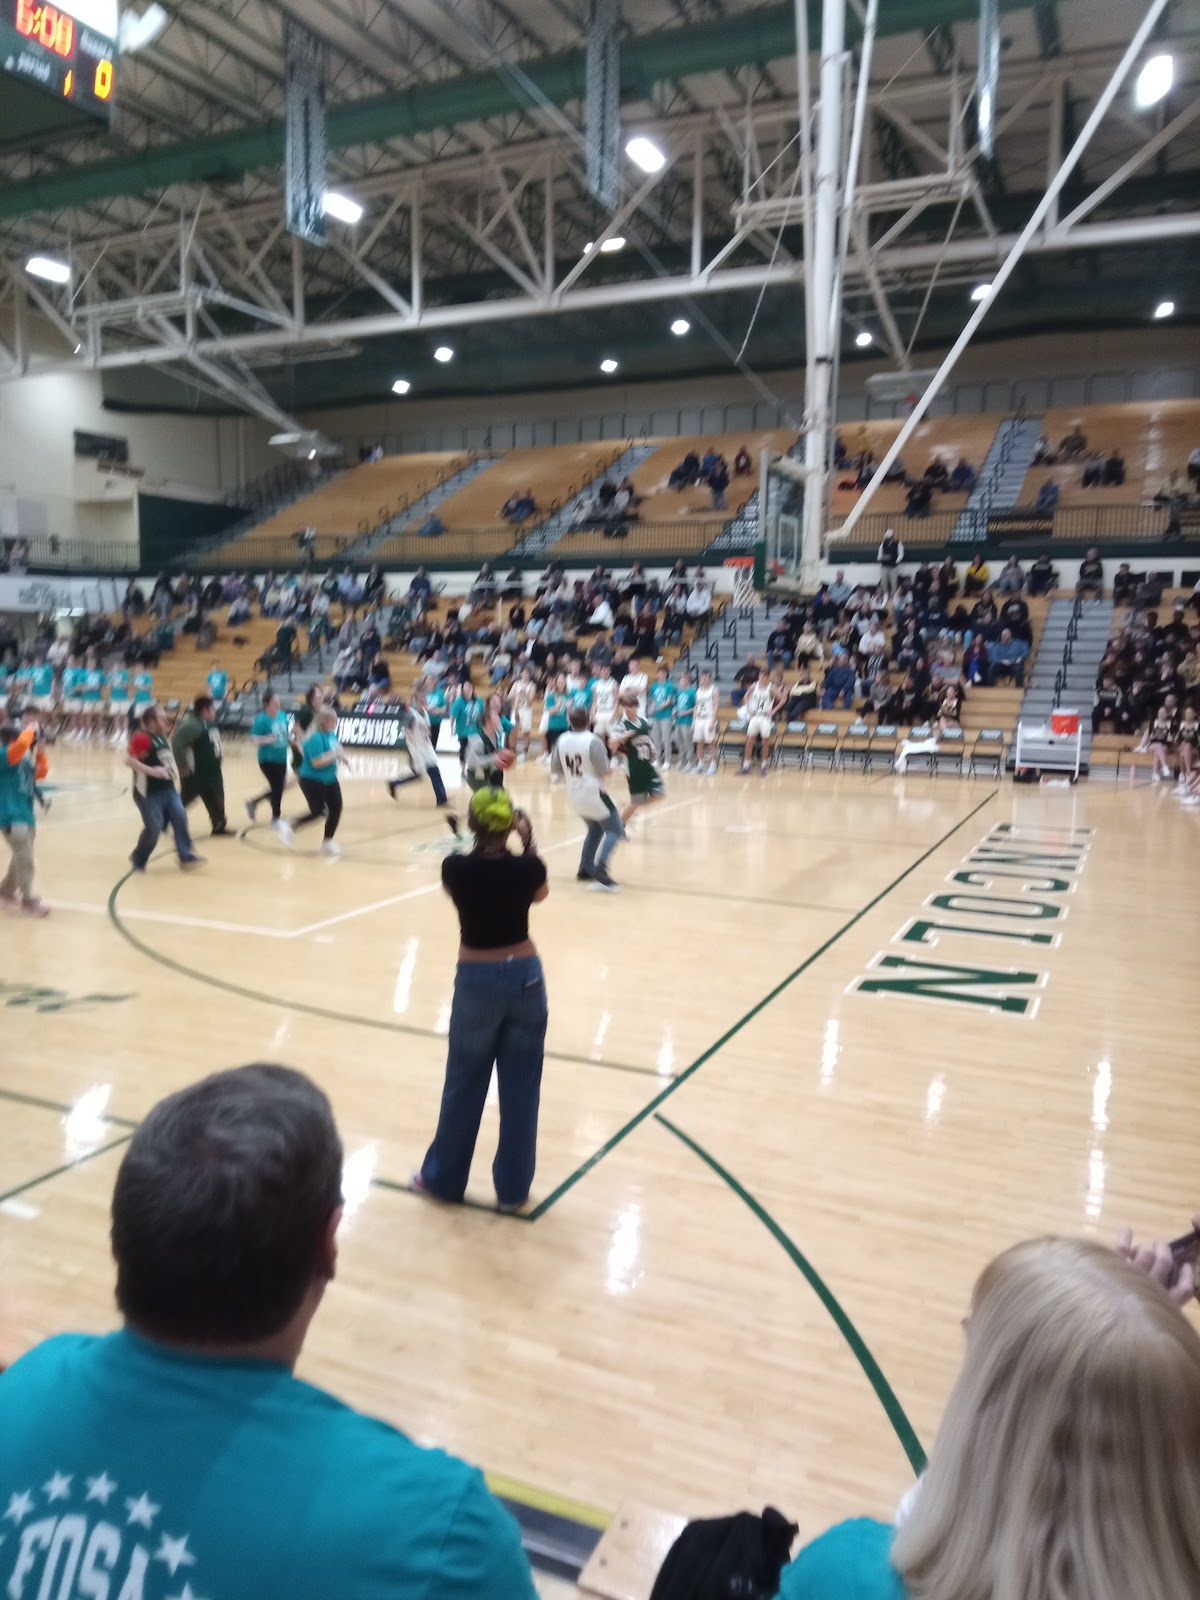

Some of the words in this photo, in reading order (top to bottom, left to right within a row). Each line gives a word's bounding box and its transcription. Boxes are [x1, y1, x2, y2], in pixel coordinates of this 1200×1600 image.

[16, 0, 74, 57] 6:00
[94, 58, 113, 99] 0
[565, 753, 584, 778] 42
[844, 821, 1097, 1020] LINCOLN
[7, 1513, 150, 1600] FOSA
